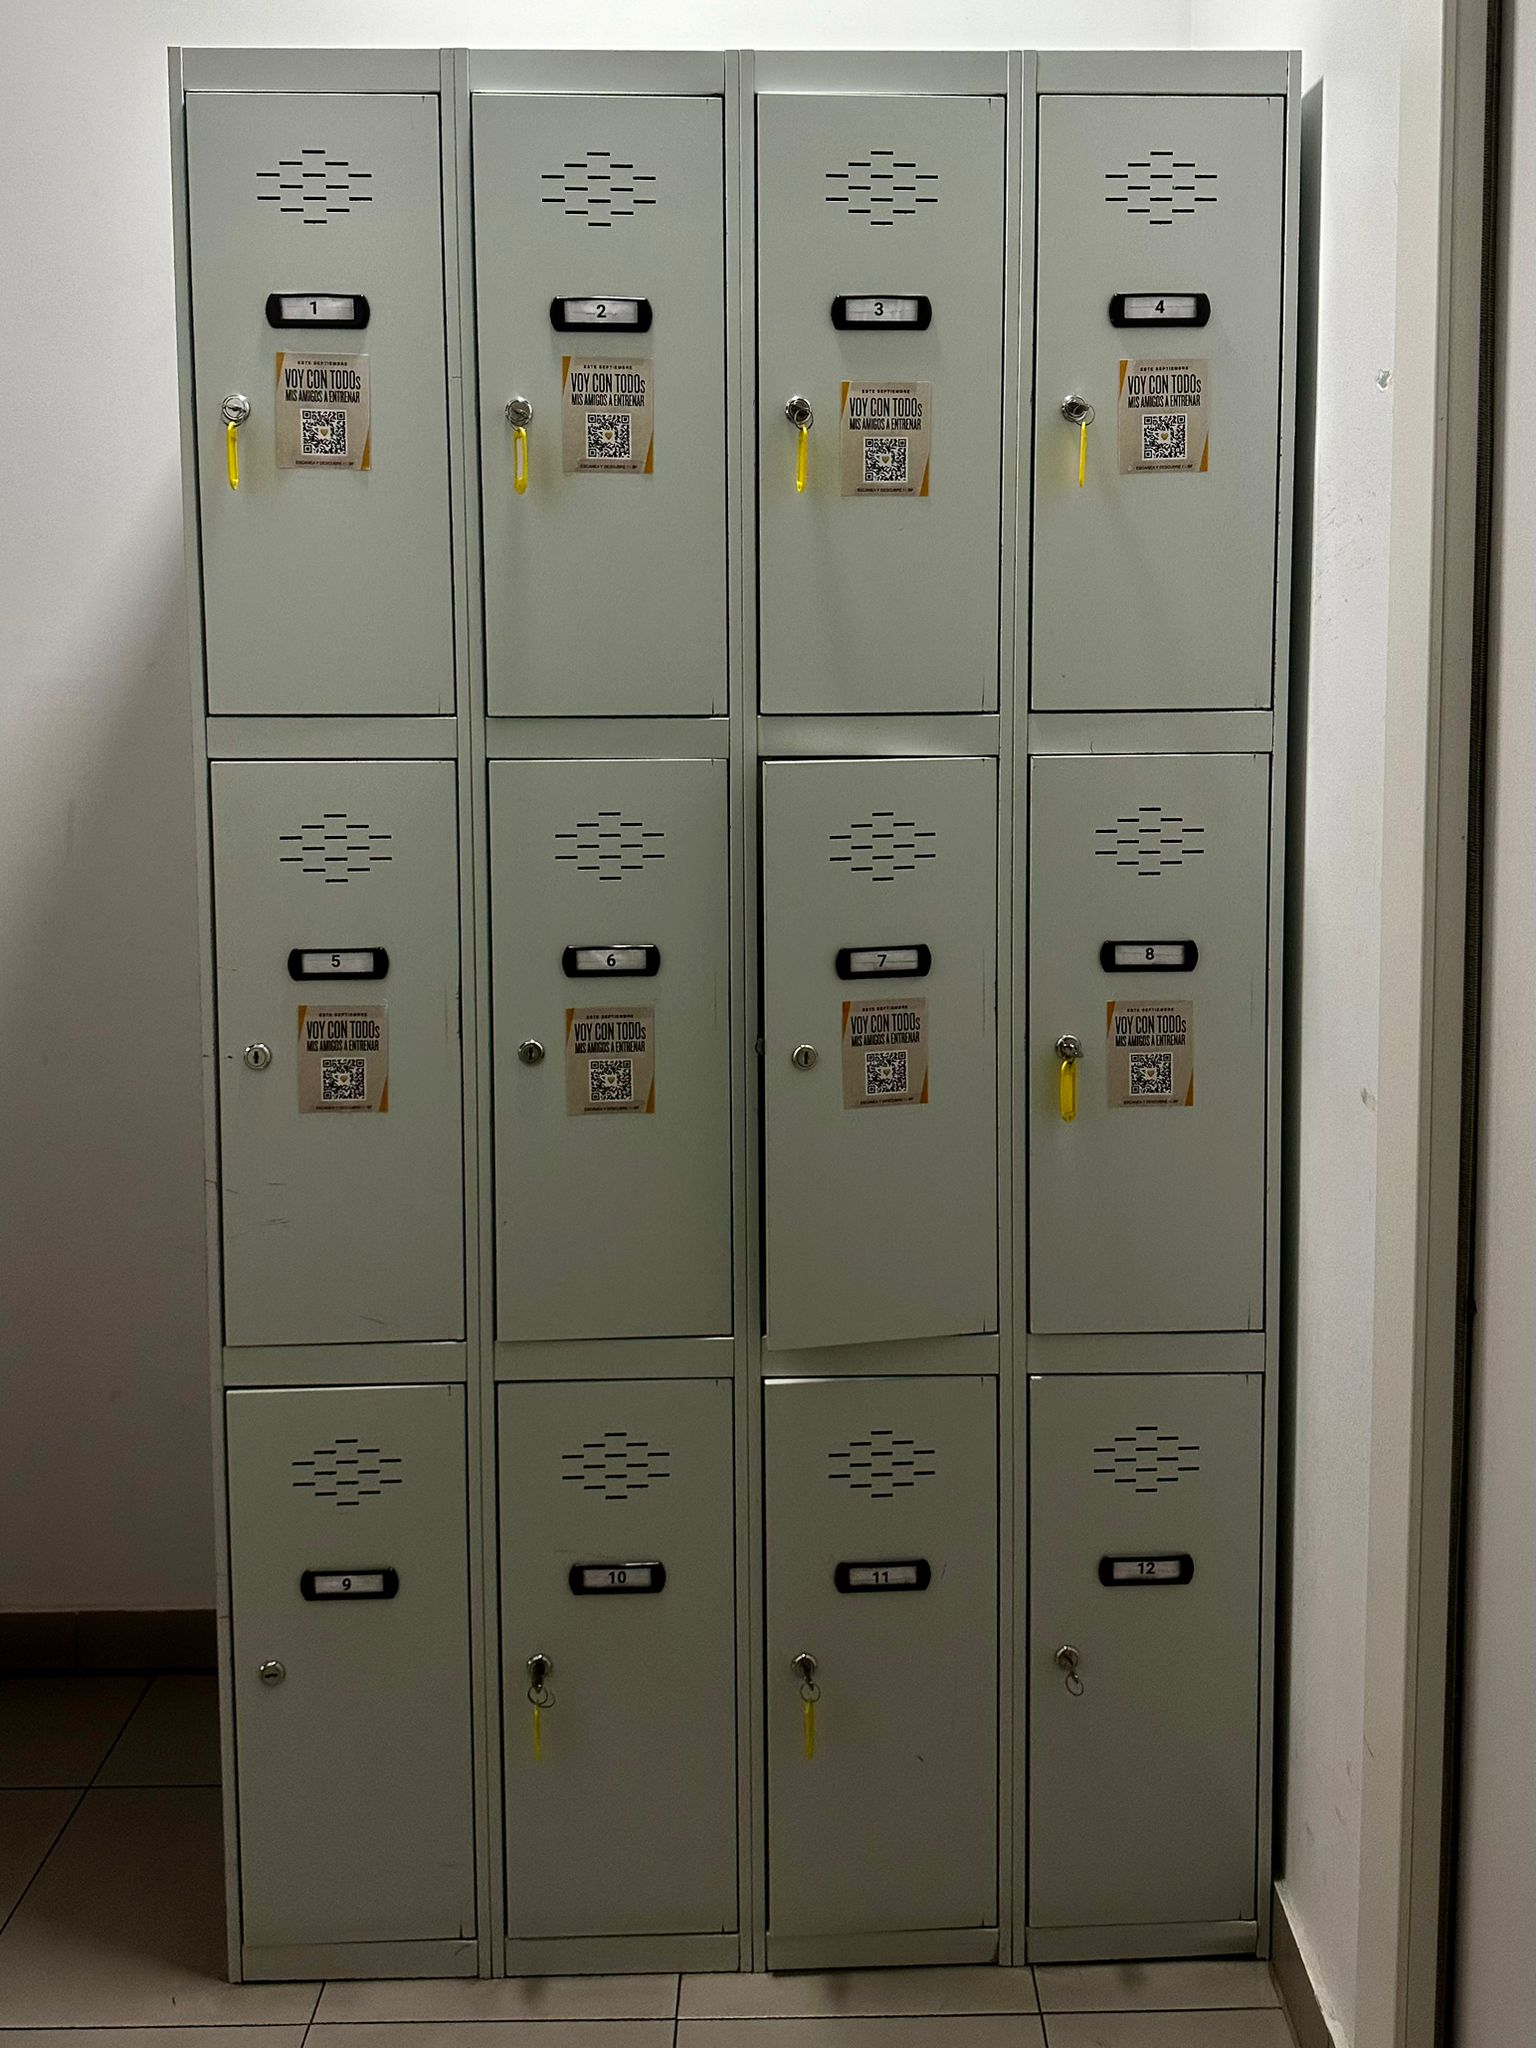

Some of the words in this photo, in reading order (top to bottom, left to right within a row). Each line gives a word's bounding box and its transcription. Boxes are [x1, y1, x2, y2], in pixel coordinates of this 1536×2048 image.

[309, 301, 317, 315] 1
[596, 304, 607, 318] 2
[874, 302, 884, 316] 3
[1155, 300, 1165, 314] 4
[285, 368, 304, 388] VOY
[306, 369, 327, 389] CON
[571, 373, 590, 393] VOY
[592, 373, 613, 393] CON
[1128, 375, 1147, 395] VOY
[1149, 374, 1169, 395] CON
[285, 389, 298, 402] MIS
[298, 389, 323, 403] AMIGOS
[323, 390, 329, 403] A
[328, 390, 360, 403] ENTRENAR
[571, 393, 583, 406] MIS
[584, 393, 608, 407] AMIGOS
[608, 394, 614, 407] A
[613, 394, 645, 407] ENTRENAR
[1128, 396, 1140, 409] MIS
[1140, 395, 1164, 409] AMIGOS
[1164, 395, 1170, 408] A
[1169, 394, 1201, 407] ENTRENAR
[849, 397, 868, 417] VOY
[870, 397, 890, 418] CON
[849, 418, 861, 431] MIS
[862, 417, 886, 431] AMIGOS
[886, 418, 891, 431] A
[891, 417, 921, 431] ENTRENAR
[606, 953, 616, 967] 6
[1145, 947, 1155, 960] 8
[331, 955, 341, 968] 5
[877, 954, 887, 968] 7
[306, 1021, 325, 1040] VOY
[327, 1020, 348, 1040] CON
[851, 1016, 869, 1035] VOY
[870, 1014, 890, 1033] CON
[1115, 1016, 1133, 1035] VOY
[1135, 1015, 1155, 1035] CON
[574, 1023, 593, 1042] VOY
[595, 1022, 614, 1041] CON
[851, 1035, 863, 1047] MIS
[863, 1034, 886, 1047] AMIGOS
[886, 1033, 891, 1045] A
[891, 1031, 920, 1044] ENTRENAR
[307, 1040, 319, 1052] MIS
[319, 1039, 343, 1053] AMIGOS
[343, 1039, 349, 1052] A
[348, 1039, 379, 1052] ENTRENAR
[575, 1042, 586, 1054] MIS
[587, 1041, 610, 1054] AMIGOS
[610, 1041, 616, 1053] A
[615, 1040, 645, 1053] ENTRENAR
[1115, 1035, 1127, 1047] MIS
[1127, 1035, 1151, 1048] AMIGOS
[1151, 1034, 1156, 1047] A
[1156, 1034, 1186, 1046] ENTRENAR
[1137, 1562, 1156, 1575] 12
[342, 1578, 352, 1591] 9
[608, 1571, 627, 1584] 10
[872, 1571, 889, 1584] 11
